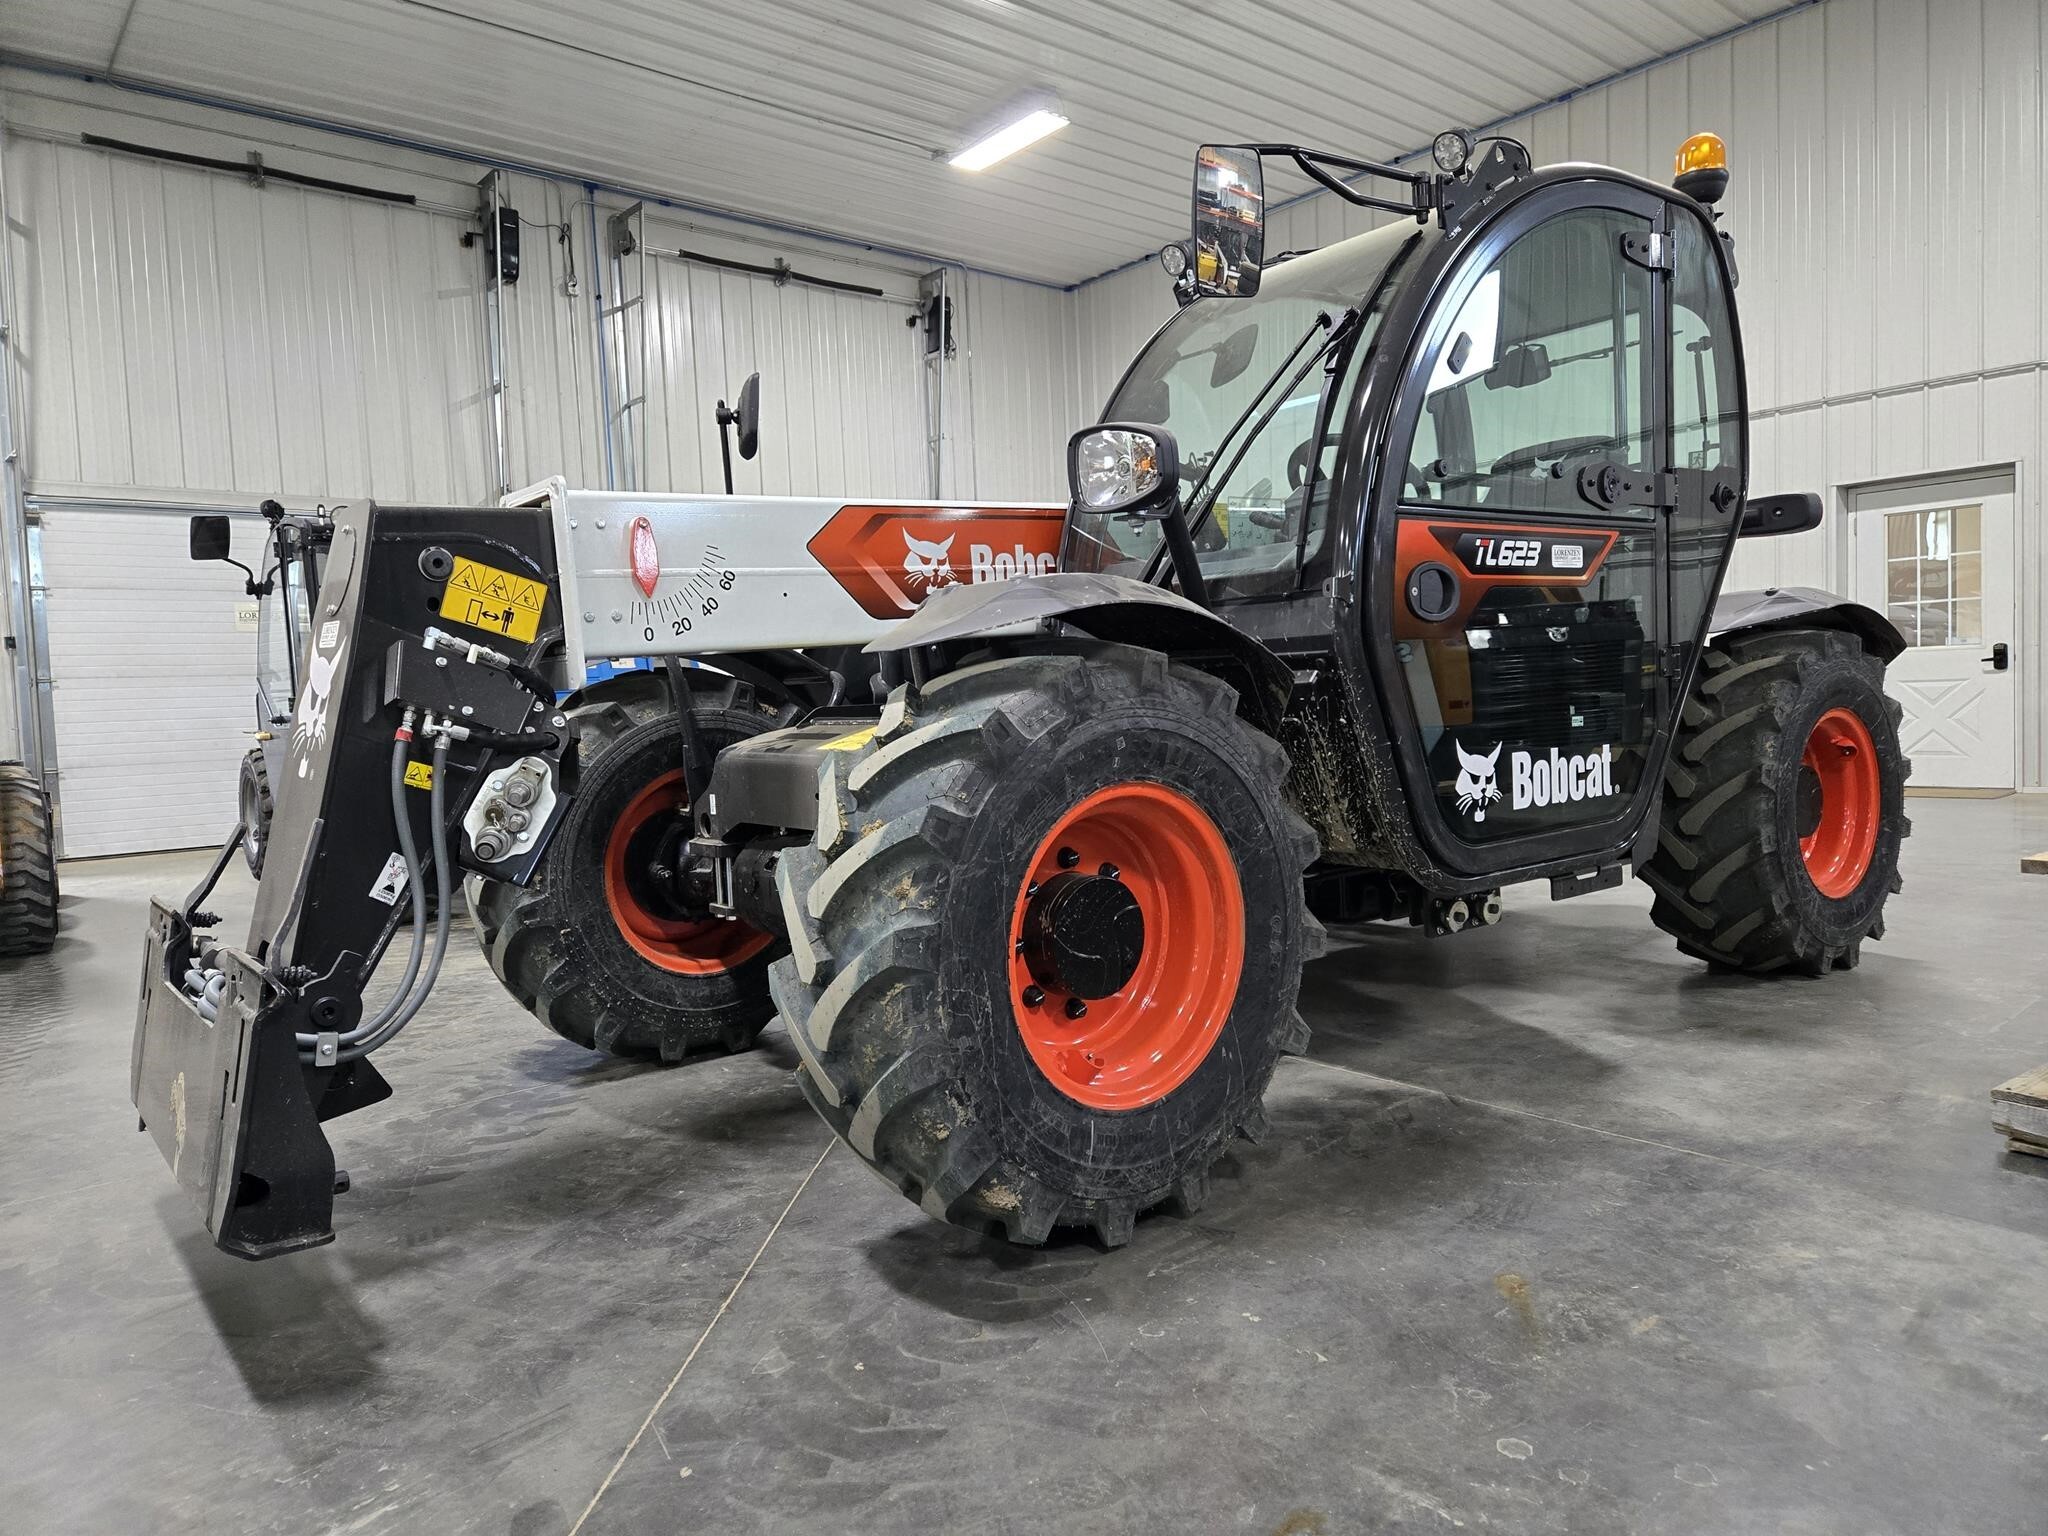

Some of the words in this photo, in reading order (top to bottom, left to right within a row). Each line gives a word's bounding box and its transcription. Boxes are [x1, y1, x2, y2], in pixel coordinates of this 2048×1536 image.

[970, 544, 1062, 585] Bobc
[644, 627, 654, 642] 0
[672, 617, 692, 636] 20
[702, 597, 719, 616] 40
[719, 570, 736, 591] 60
[1512, 744, 1613, 810] Bobcat
